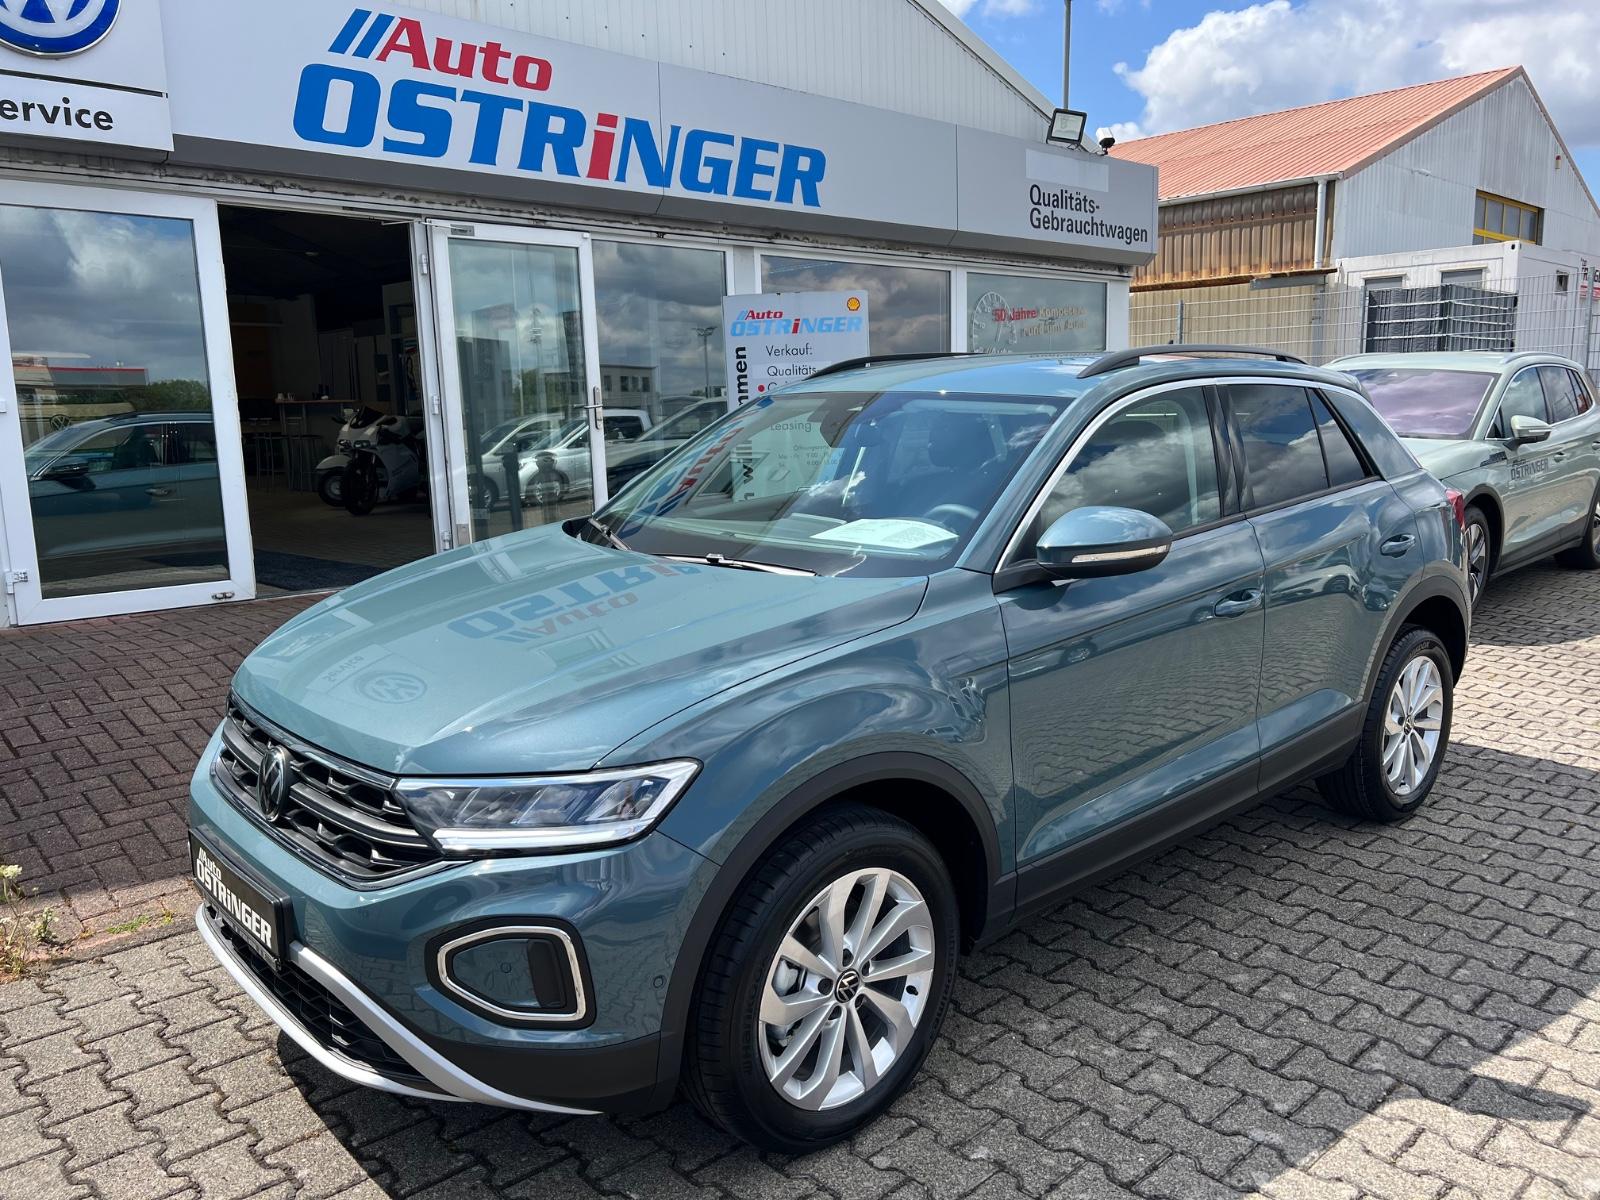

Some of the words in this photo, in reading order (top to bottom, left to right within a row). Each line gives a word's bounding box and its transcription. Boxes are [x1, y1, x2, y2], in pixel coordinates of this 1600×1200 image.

[376, 17, 553, 91] Auto
[0, 97, 113, 131] ervice
[1029, 184, 1100, 214] Qualitäts-
[1029, 207, 1148, 245] Gebrauchtwagen
[745, 309, 784, 320] Auto
[765, 342, 813, 357] Verkauf:
[770, 421, 812, 433] Leasing
